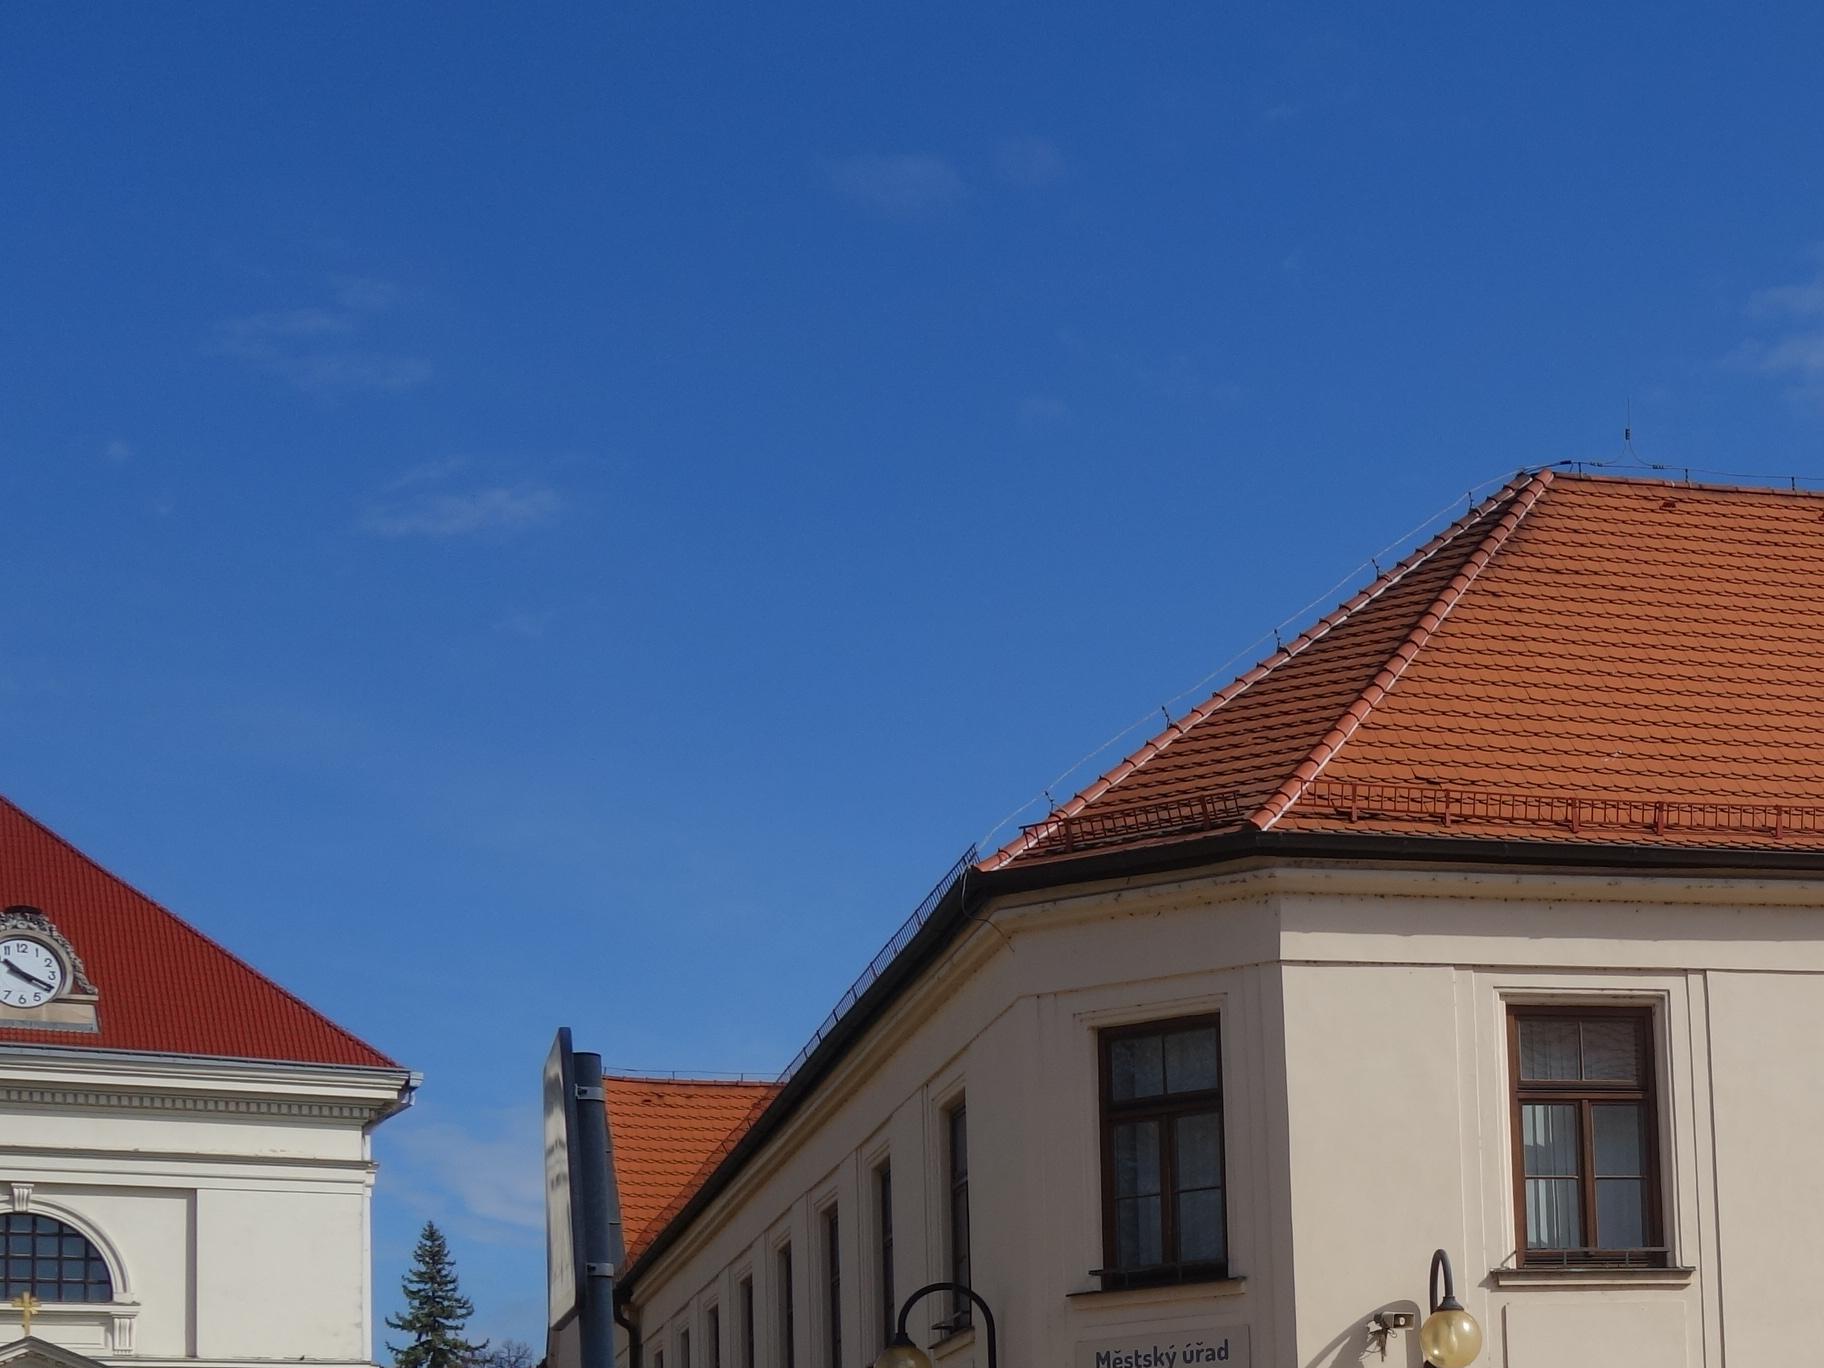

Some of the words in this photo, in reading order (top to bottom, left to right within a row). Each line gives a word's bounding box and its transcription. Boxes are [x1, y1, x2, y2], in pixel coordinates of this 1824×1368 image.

[4, 945, 10, 956] 11
[16, 943, 29, 954] 12
[35, 947, 39, 958] 1
[44, 958, 53, 968] 2
[48, 971, 56, 981] 3
[3, 990, 12, 1000] 7
[18, 995, 27, 1005] 6
[33, 992, 42, 1001] 5
[1182, 1339, 1229, 1364] úřad
